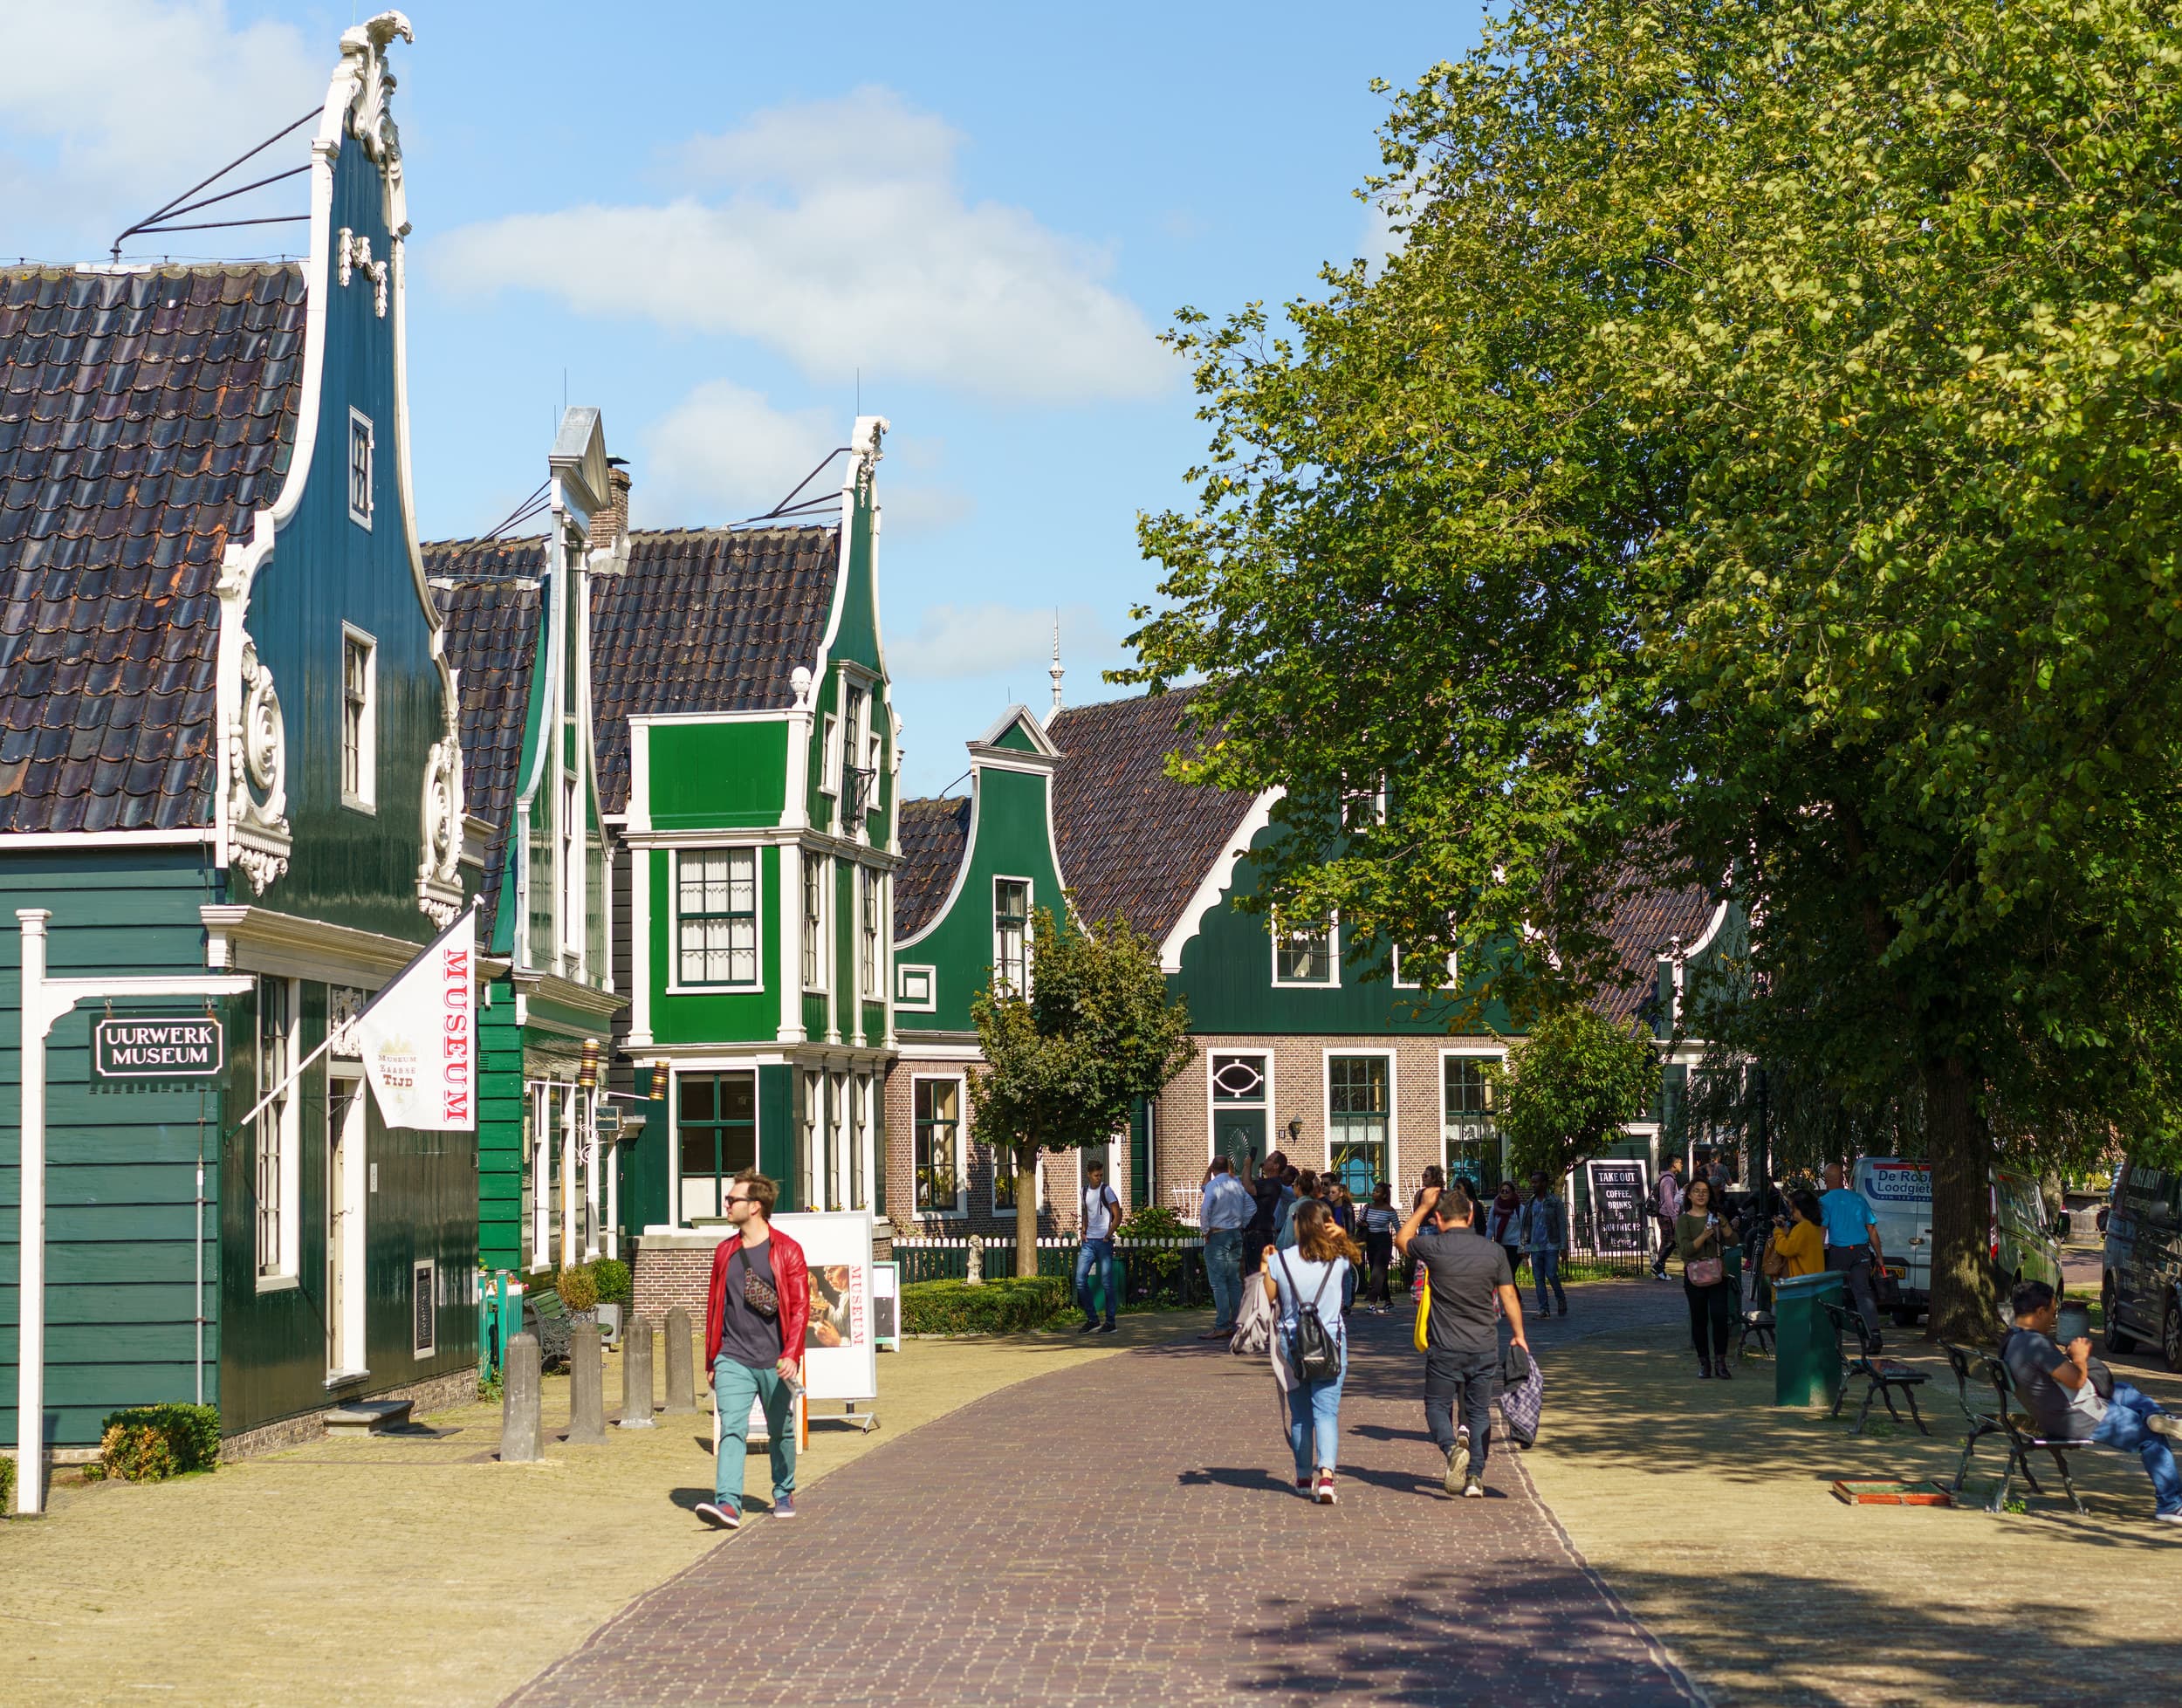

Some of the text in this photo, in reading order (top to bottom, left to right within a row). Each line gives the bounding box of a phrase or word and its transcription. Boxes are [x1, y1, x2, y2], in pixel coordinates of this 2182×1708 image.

[106, 1026, 214, 1045] UURWERK
[443, 949, 468, 1124] MUSEUM
[112, 1047, 209, 1065] MUSEUM
[382, 1074, 413, 1087] TIJD
[1598, 1172, 1635, 1182] TAKE OUT
[1878, 1170, 1896, 1182] De
[852, 1266, 864, 1345] MUSEUM
